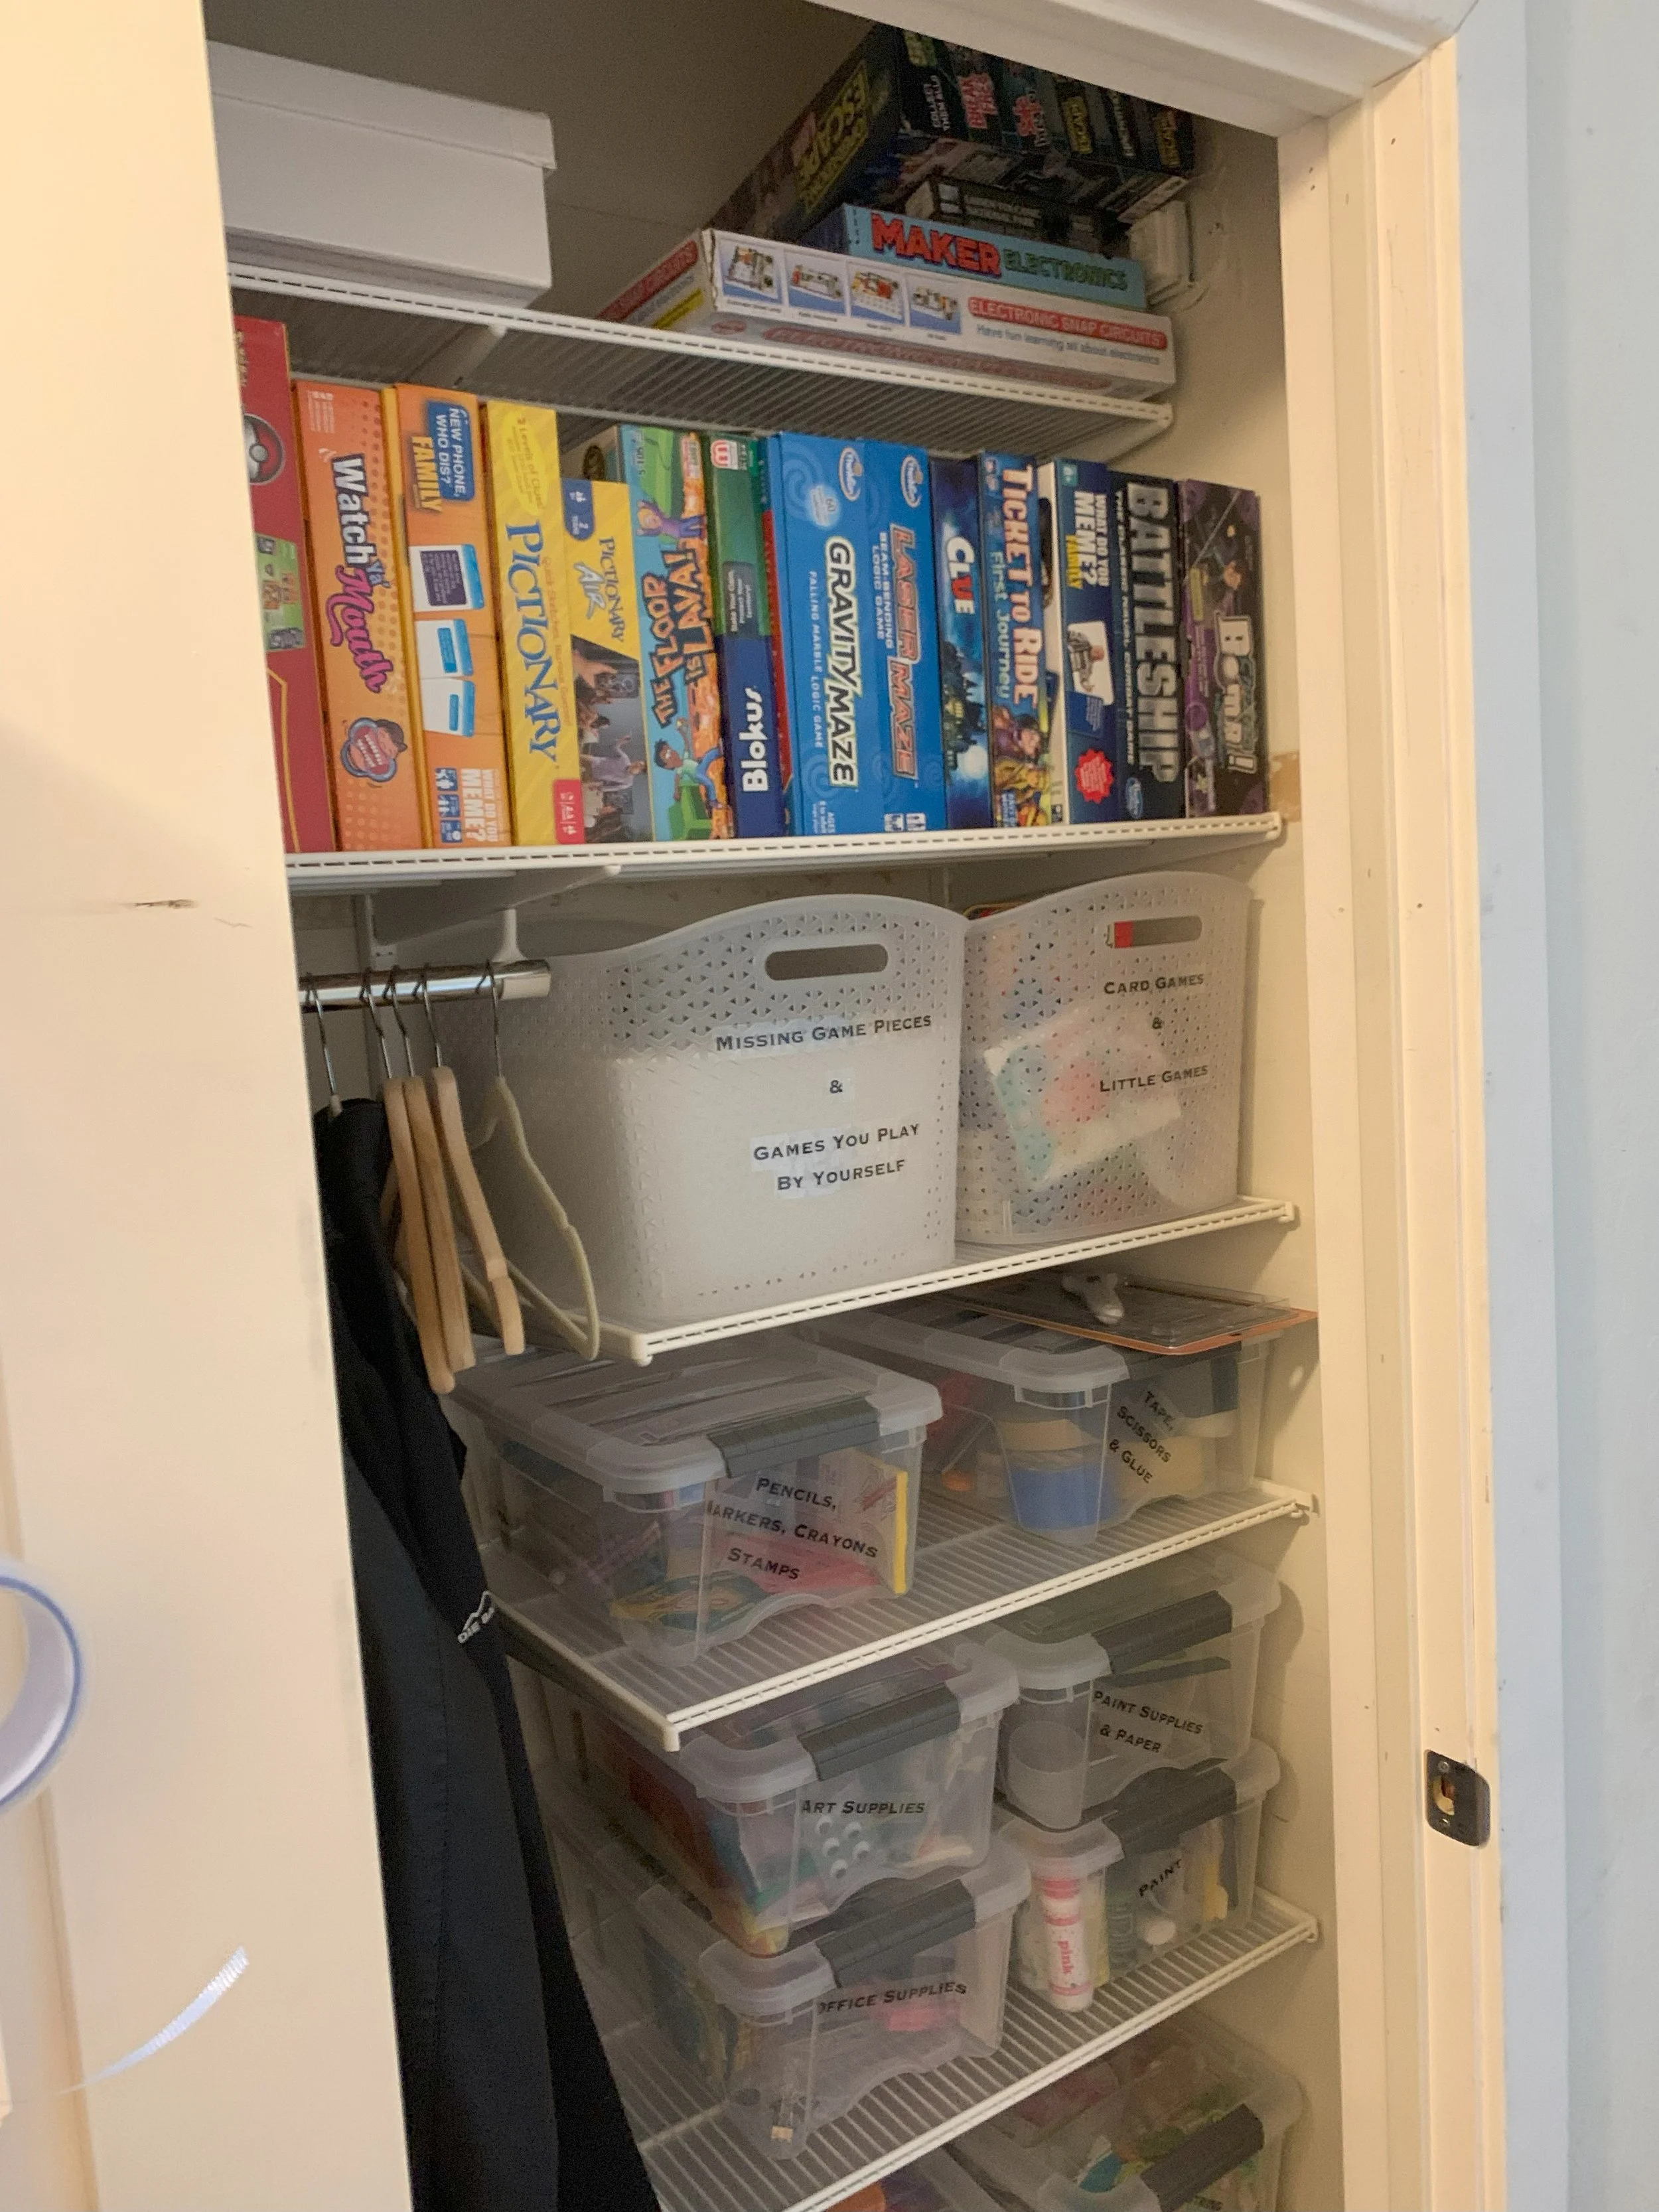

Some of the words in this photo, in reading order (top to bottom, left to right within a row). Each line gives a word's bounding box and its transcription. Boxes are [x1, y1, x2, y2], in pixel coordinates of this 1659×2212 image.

[870, 211, 1003, 279] MAKER
[1003, 248, 1129, 291] ELECTRONICS
[970, 299, 1059, 329] ELECTRONIC
[1061, 316, 1096, 336] SNAP
[435, 414, 450, 449] WHO
[449, 407, 463, 441] NEW
[412, 436, 442, 512] FAMILY
[439, 452, 453, 484] DIS?
[452, 444, 468, 498] PHONE,
[330, 453, 376, 569] Watch
[1002, 465, 1033, 587] TICKET
[1095, 493, 1108, 536] WHAT
[1116, 490, 1125, 522] THE
[1074, 490, 1098, 586] MEME?
[1096, 537, 1109, 557] DO
[871, 545, 881, 591] LOGIC
[945, 536, 976, 615] CLUE
[989, 550, 1008, 601] First
[1065, 535, 1084, 590] FAMILY
[1096, 559, 1110, 587] YOU
[573, 561, 607, 621] AIR
[599, 536, 626, 642] PICTIONARY
[662, 548, 713, 658] LAVA!
[809, 570, 820, 621] FALLING
[879, 532, 894, 650] BEAM-BENDING
[890, 523, 920, 664] LASER
[1009, 592, 1031, 623] TO
[326, 565, 394, 694] Mouth
[640, 571, 685, 679] FLOOR
[828, 539, 858, 688] GRAVITY
[875, 595, 885, 640] GAME
[1121, 595, 1131, 646] NAVAL
[1127, 482, 1179, 782] BATTLESHIP
[505, 519, 561, 764] PICTIONARY
[812, 624, 823, 674] MARBLE
[996, 609, 1011, 700] Journey
[1012, 627, 1043, 710] RIDE
[1123, 651, 1133, 717] COMBAT
[650, 678, 679, 729] THE
[811, 676, 821, 712] LOGIC
[738, 686, 769, 792] Blokus
[813, 715, 824, 749] GAME
[827, 684, 857, 782] MAZE
[887, 656, 919, 781] MAZE
[461, 768, 486, 842] MEME?
[482, 769, 494, 800] WHAT
[484, 802, 496, 818] DO
[486, 821, 498, 842] YOU
[1103, 979, 1150, 995] CARD
[1154, 973, 1204, 990] GAMES
[715, 1030, 804, 1052] MISSING
[811, 1023, 867, 1041] GAME
[873, 1015, 932, 1034] PIECES
[1151, 1017, 1163, 1030] &
[829, 1079, 843, 1094] &
[1098, 1073, 1156, 1093] LITTLE
[1161, 1065, 1210, 1084] GAMES
[753, 1139, 826, 1161] GAMES
[831, 1132, 869, 1150] YOU
[877, 1123, 920, 1142] PLAY
[776, 1175, 804, 1191] BY
[812, 1159, 906, 1187] YOURSELF
[1116, 1405, 1173, 1464] SCISSORS
[1108, 1438, 1120, 1453] &
[1120, 1449, 1153, 1485] GLUE
[755, 1477, 837, 1511] PENCILS,
[727, 1547, 801, 1581] STAMPS
[794, 1523, 879, 1560] CRAYONS
[1091, 1690, 1137, 1714] PAINT
[1138, 1704, 1204, 1735] SUPPLIES
[1098, 1724, 1112, 1738] &
[1114, 1728, 1163, 1754] PAPER
[800, 1799, 837, 1814] ART
[841, 1799, 926, 1815] SUPPLIES
[1137, 1858, 1183, 1897] PAINT
[1057, 1940, 1075, 1975] pink
[883, 1980, 968, 2004] SUPPLIES
